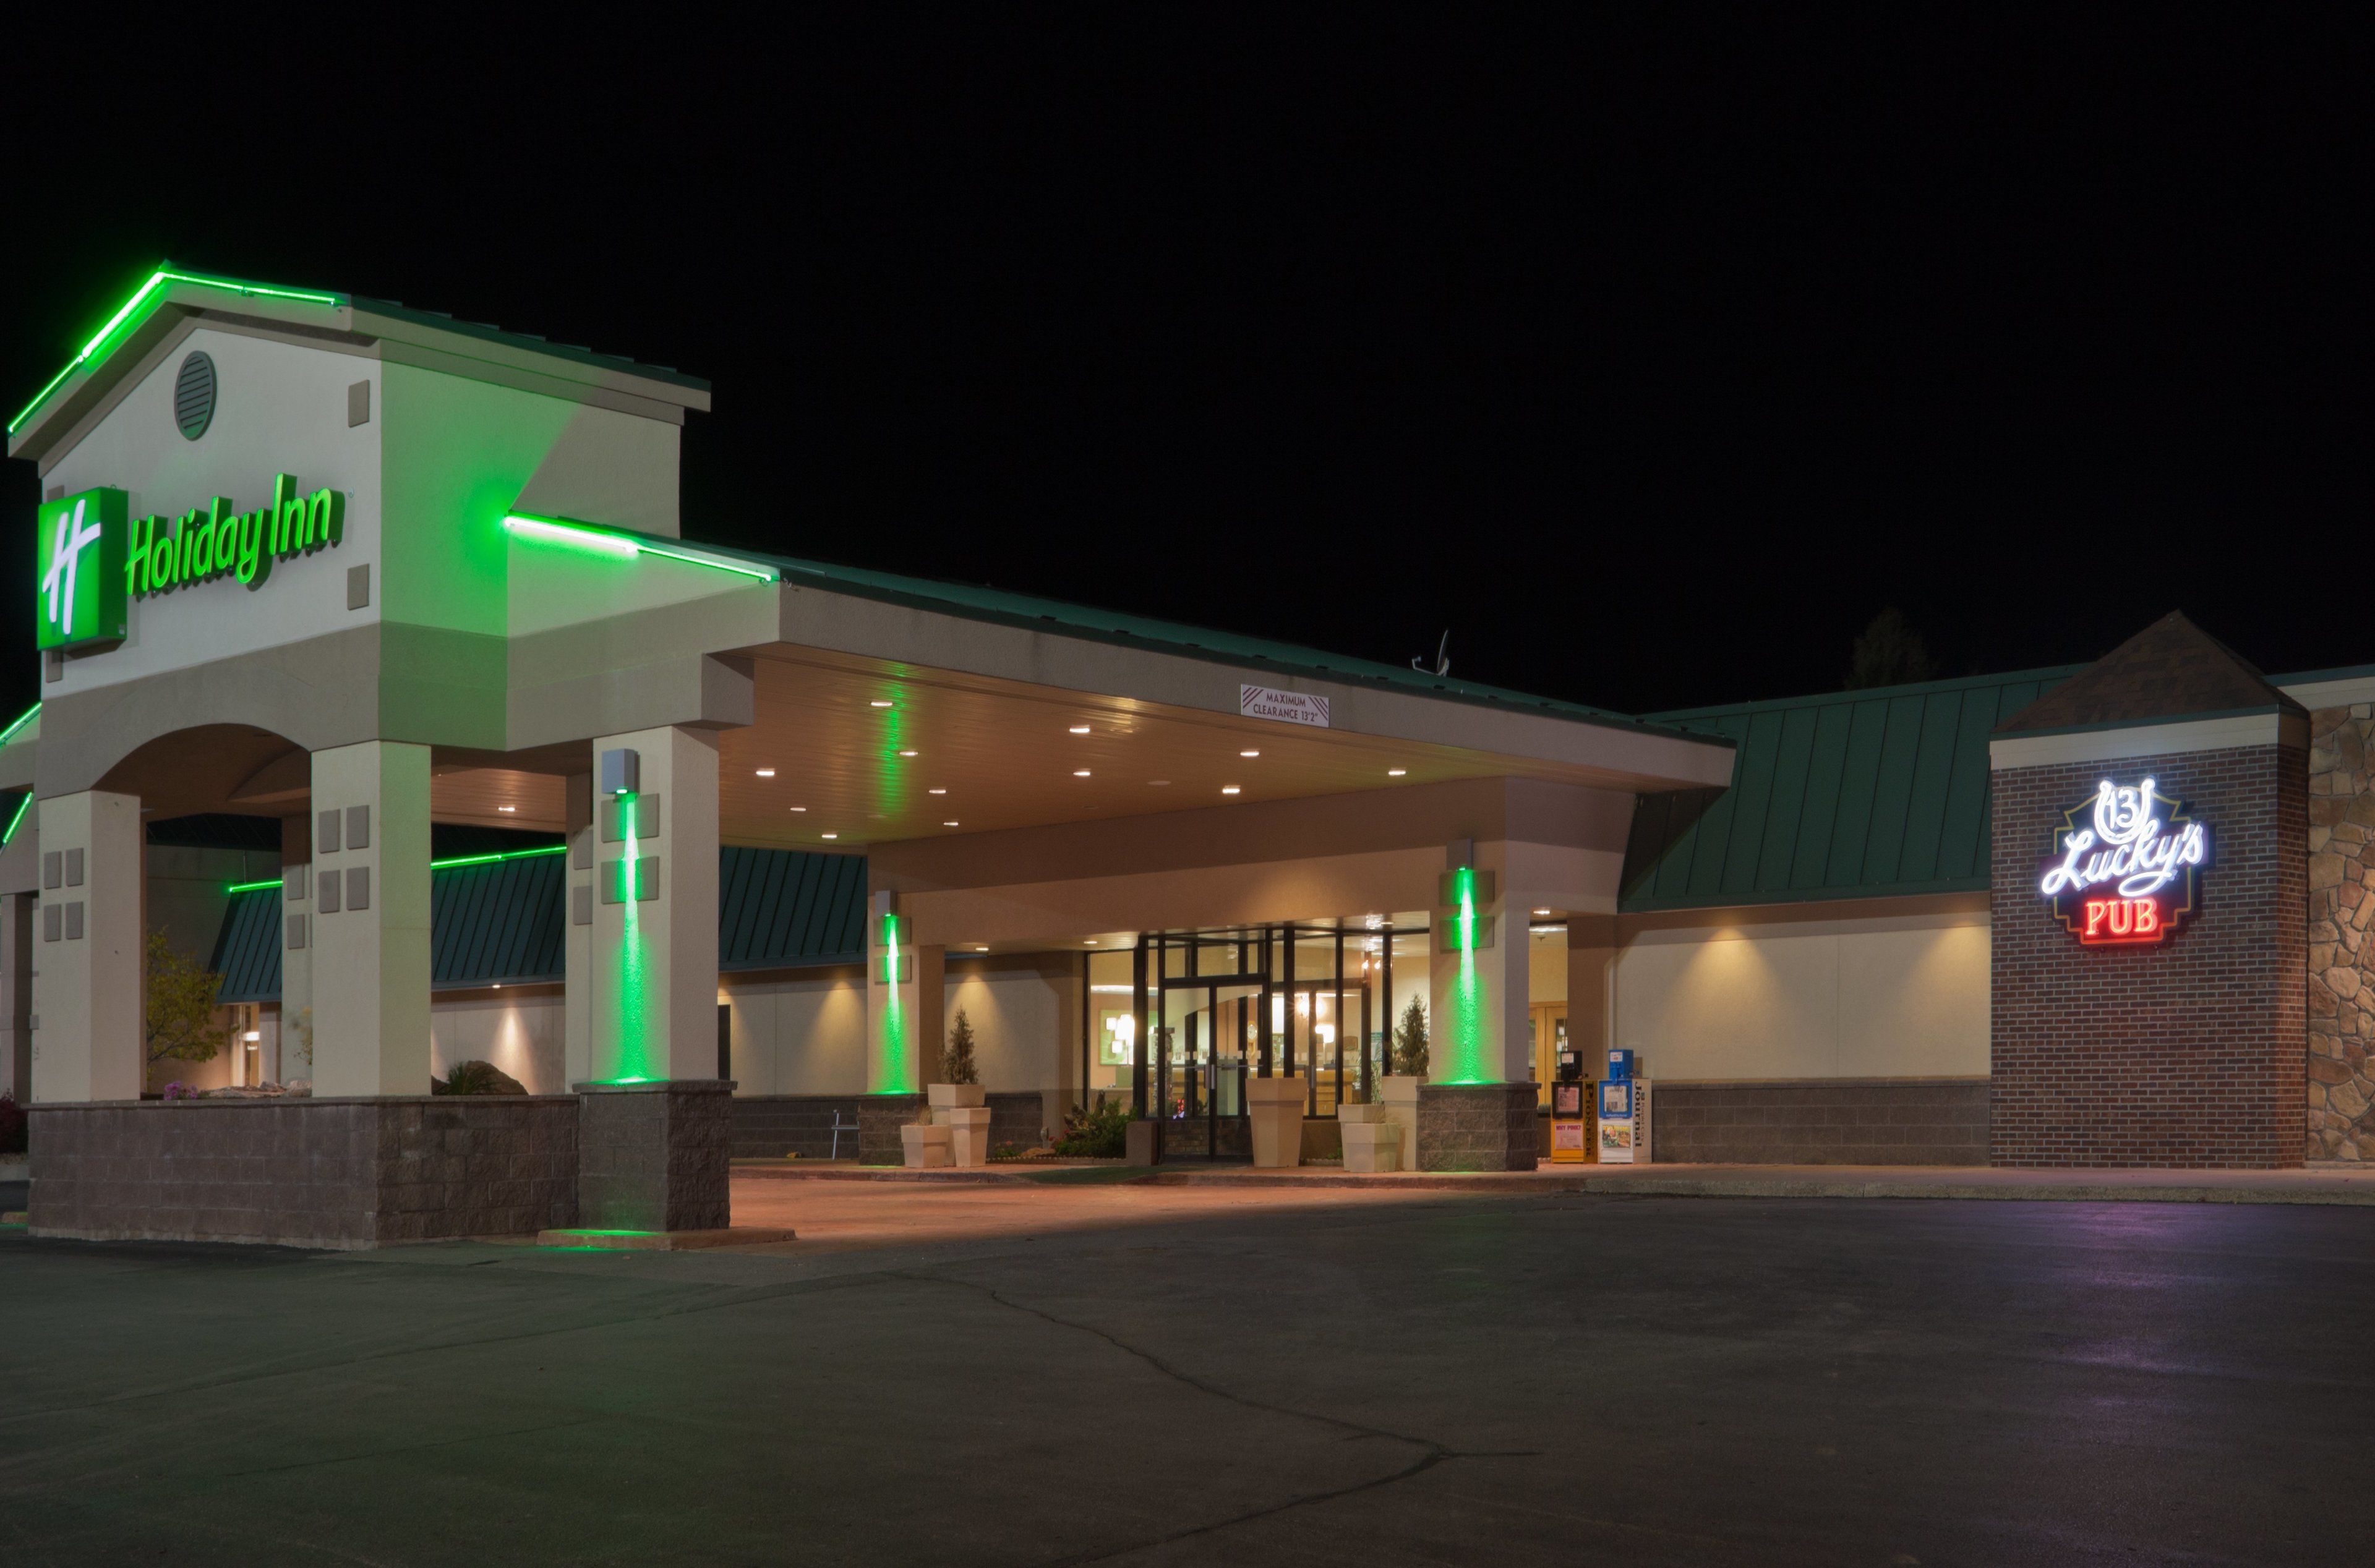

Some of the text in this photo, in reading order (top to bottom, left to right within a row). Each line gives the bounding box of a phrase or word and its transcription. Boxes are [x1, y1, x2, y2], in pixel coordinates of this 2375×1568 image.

[125, 473, 334, 596] Holiday Inn
[1253, 704, 1318, 722] CLEARANCE 13'2"
[1267, 693, 1306, 707] MAXIMUM
[2104, 788, 2138, 829] 13
[2041, 818, 2204, 897] Lucky's
[2085, 898, 2159, 935] PUB
